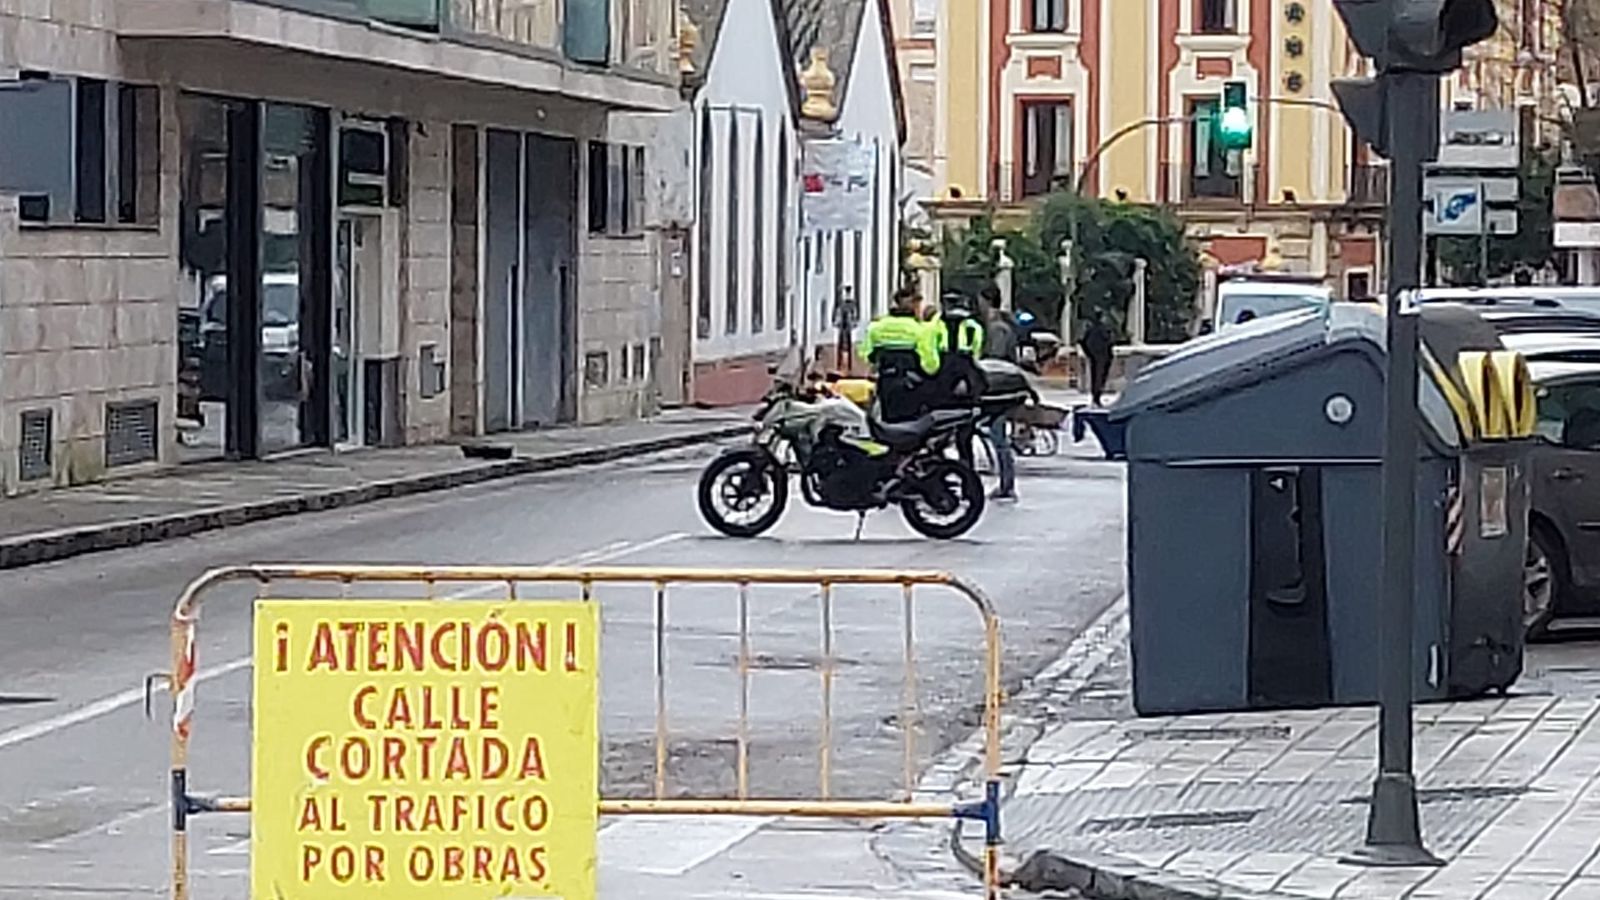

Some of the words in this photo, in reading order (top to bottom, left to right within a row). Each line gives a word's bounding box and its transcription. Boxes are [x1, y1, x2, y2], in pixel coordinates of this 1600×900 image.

[307, 609, 547, 672] ATENCIÓN
[353, 685, 499, 730] CALLE
[306, 736, 546, 780] CORTADA
[298, 796, 346, 832] AL
[368, 795, 548, 832] TRAFICO
[303, 845, 385, 881] POR
[409, 845, 546, 882] OBRAS
